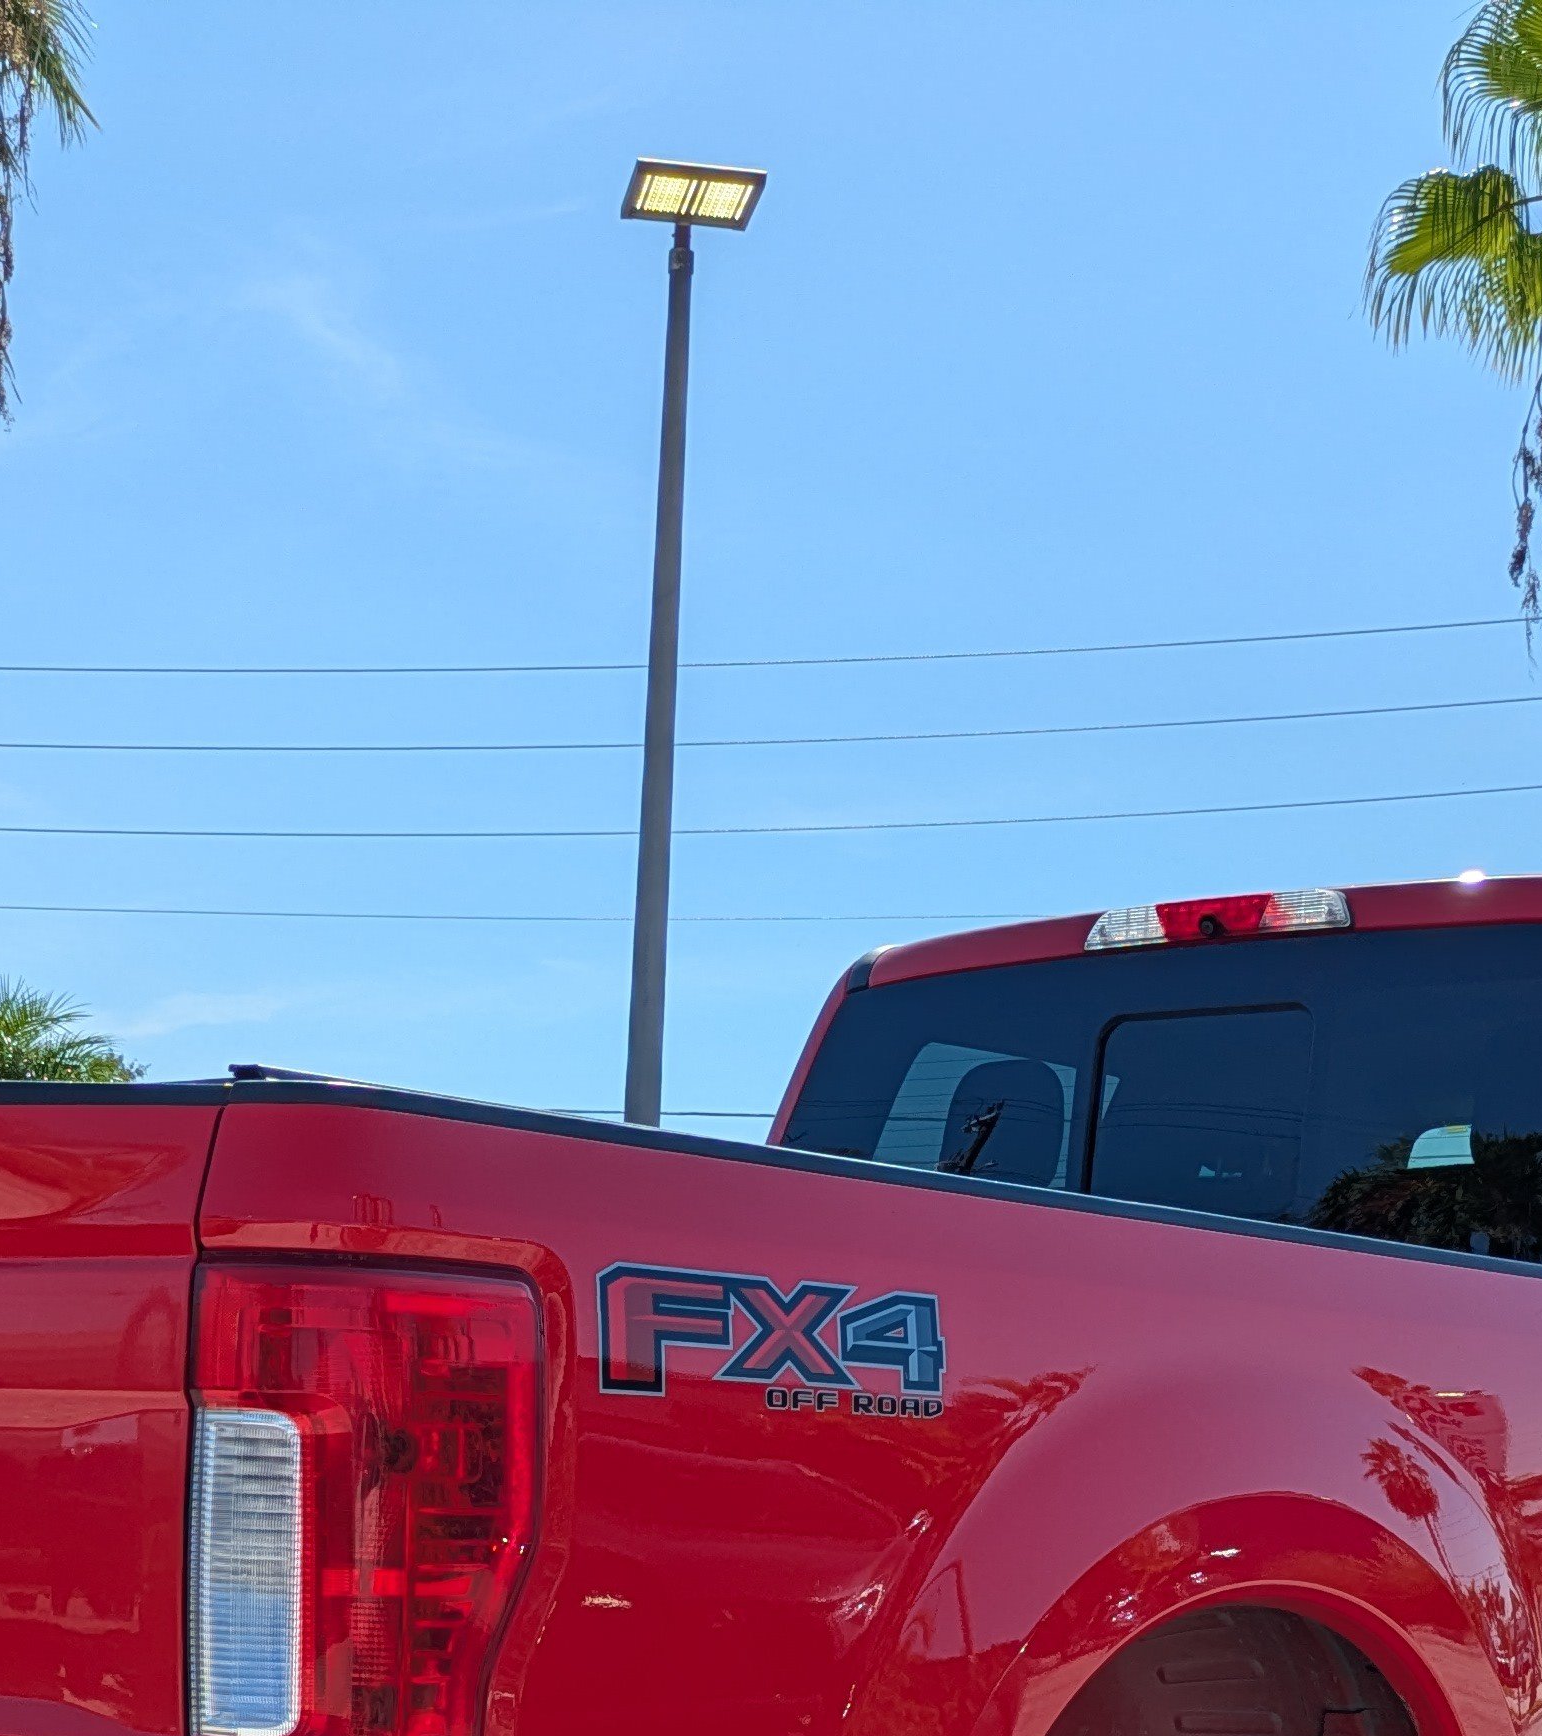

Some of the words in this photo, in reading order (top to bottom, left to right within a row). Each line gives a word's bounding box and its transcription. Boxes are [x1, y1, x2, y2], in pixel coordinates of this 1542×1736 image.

[596, 1261, 946, 1397] FX4
[765, 1386, 840, 1413] OFF
[851, 1390, 944, 1419] ROAD
